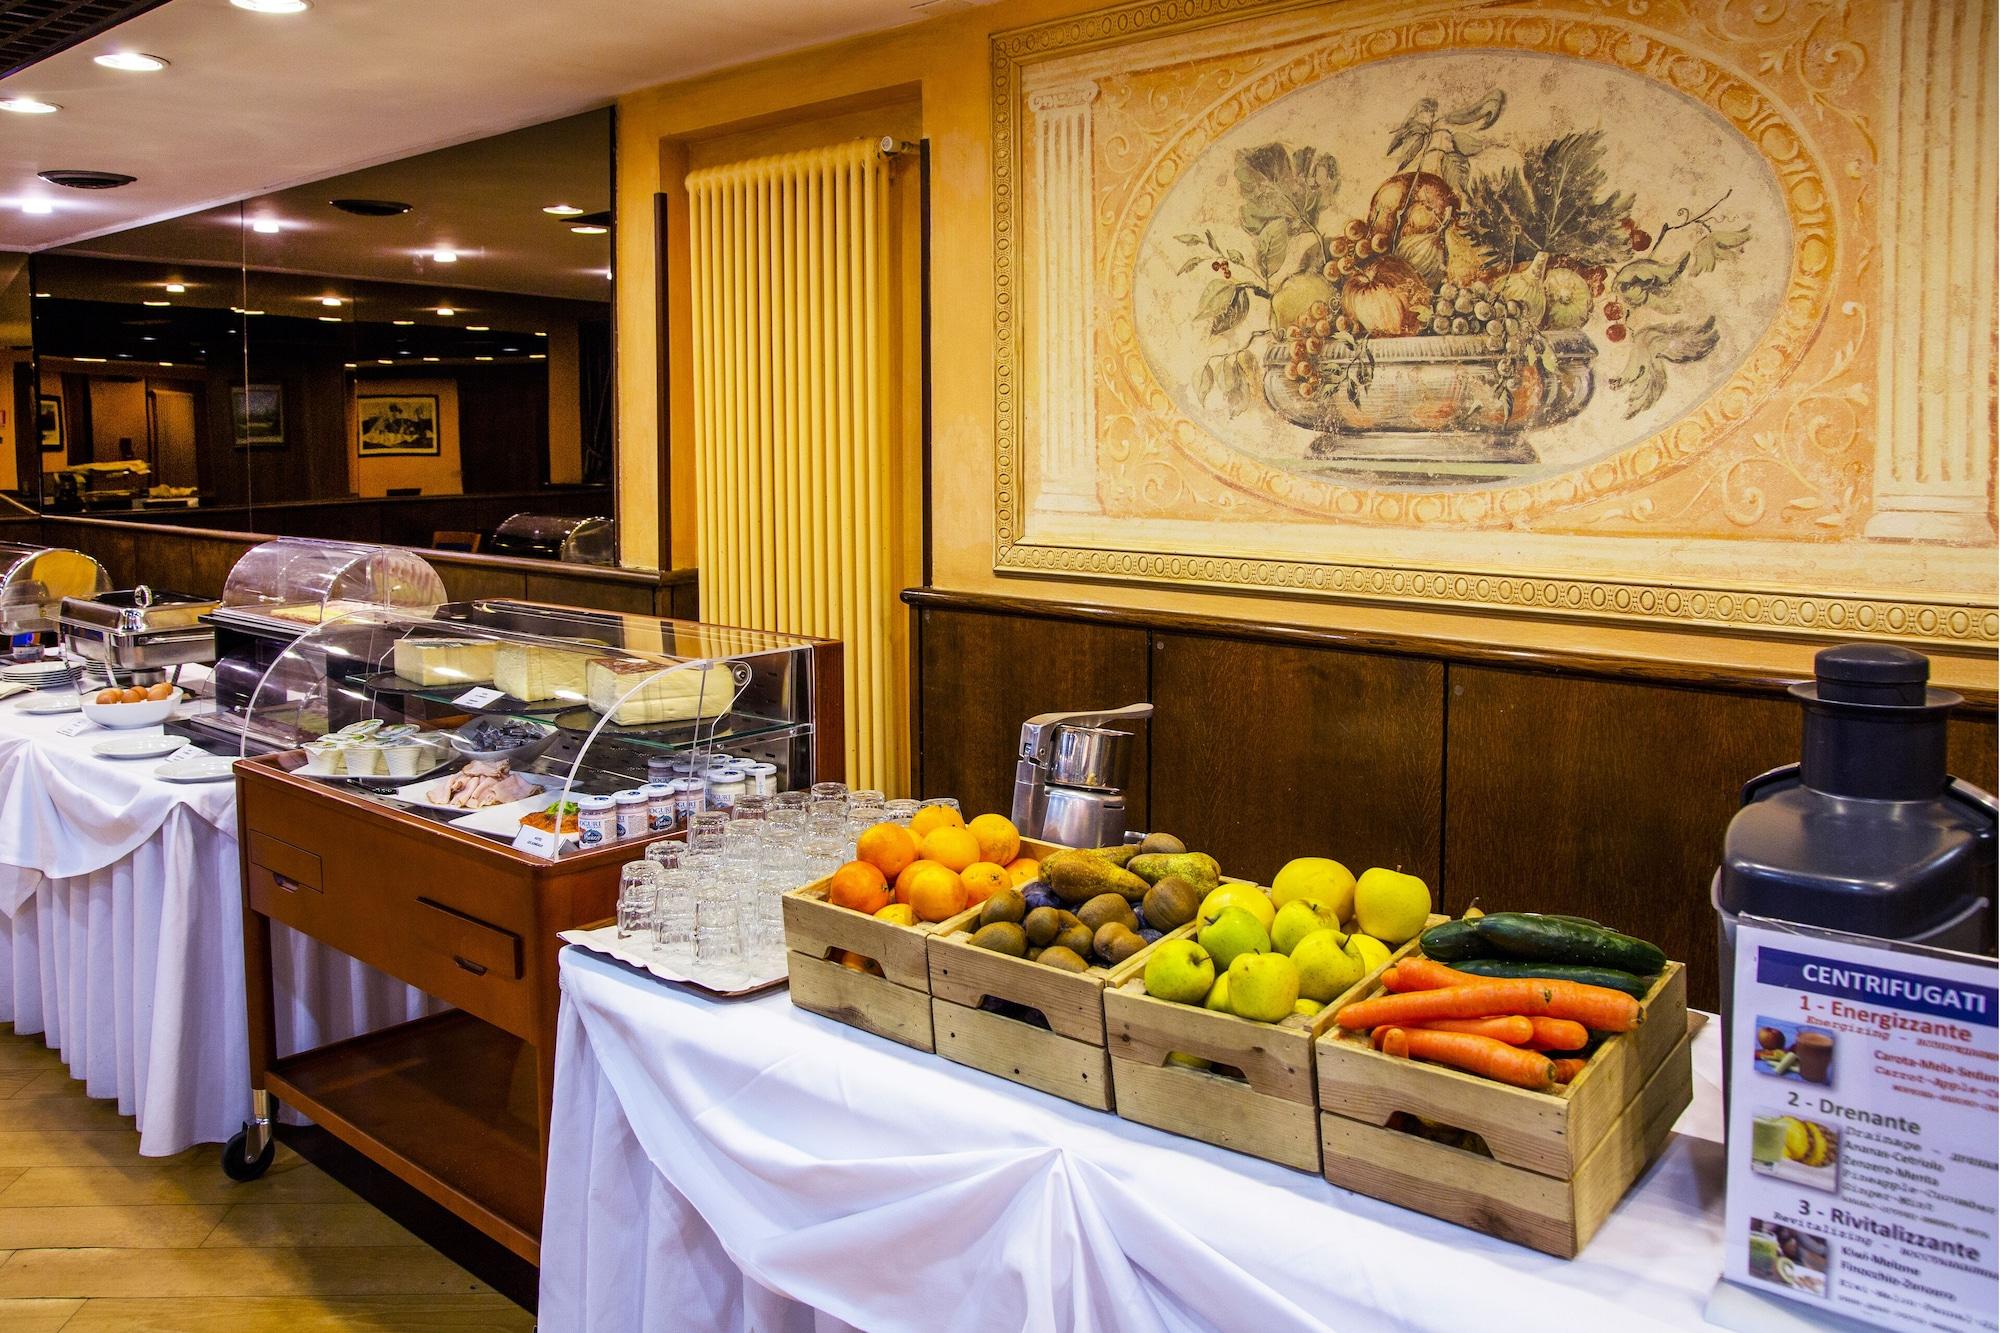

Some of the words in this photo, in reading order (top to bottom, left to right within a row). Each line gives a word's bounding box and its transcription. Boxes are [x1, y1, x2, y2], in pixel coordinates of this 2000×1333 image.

[1802, 963, 1987, 1014] CENTRIFUGATI
[1799, 995, 1810, 1011] 1
[1831, 1000, 1973, 1042] Energizzante
[1806, 1015, 1891, 1041] Energizing
[1787, 1091, 1799, 1107] 2
[1819, 1098, 1922, 1135] Drenante
[1844, 1126, 1922, 1151] Drainage
[1773, 1211, 1873, 1247] Revitalizing
[1798, 1199, 1810, 1215] 3
[1830, 1207, 1981, 1262] Rivitalizzante
